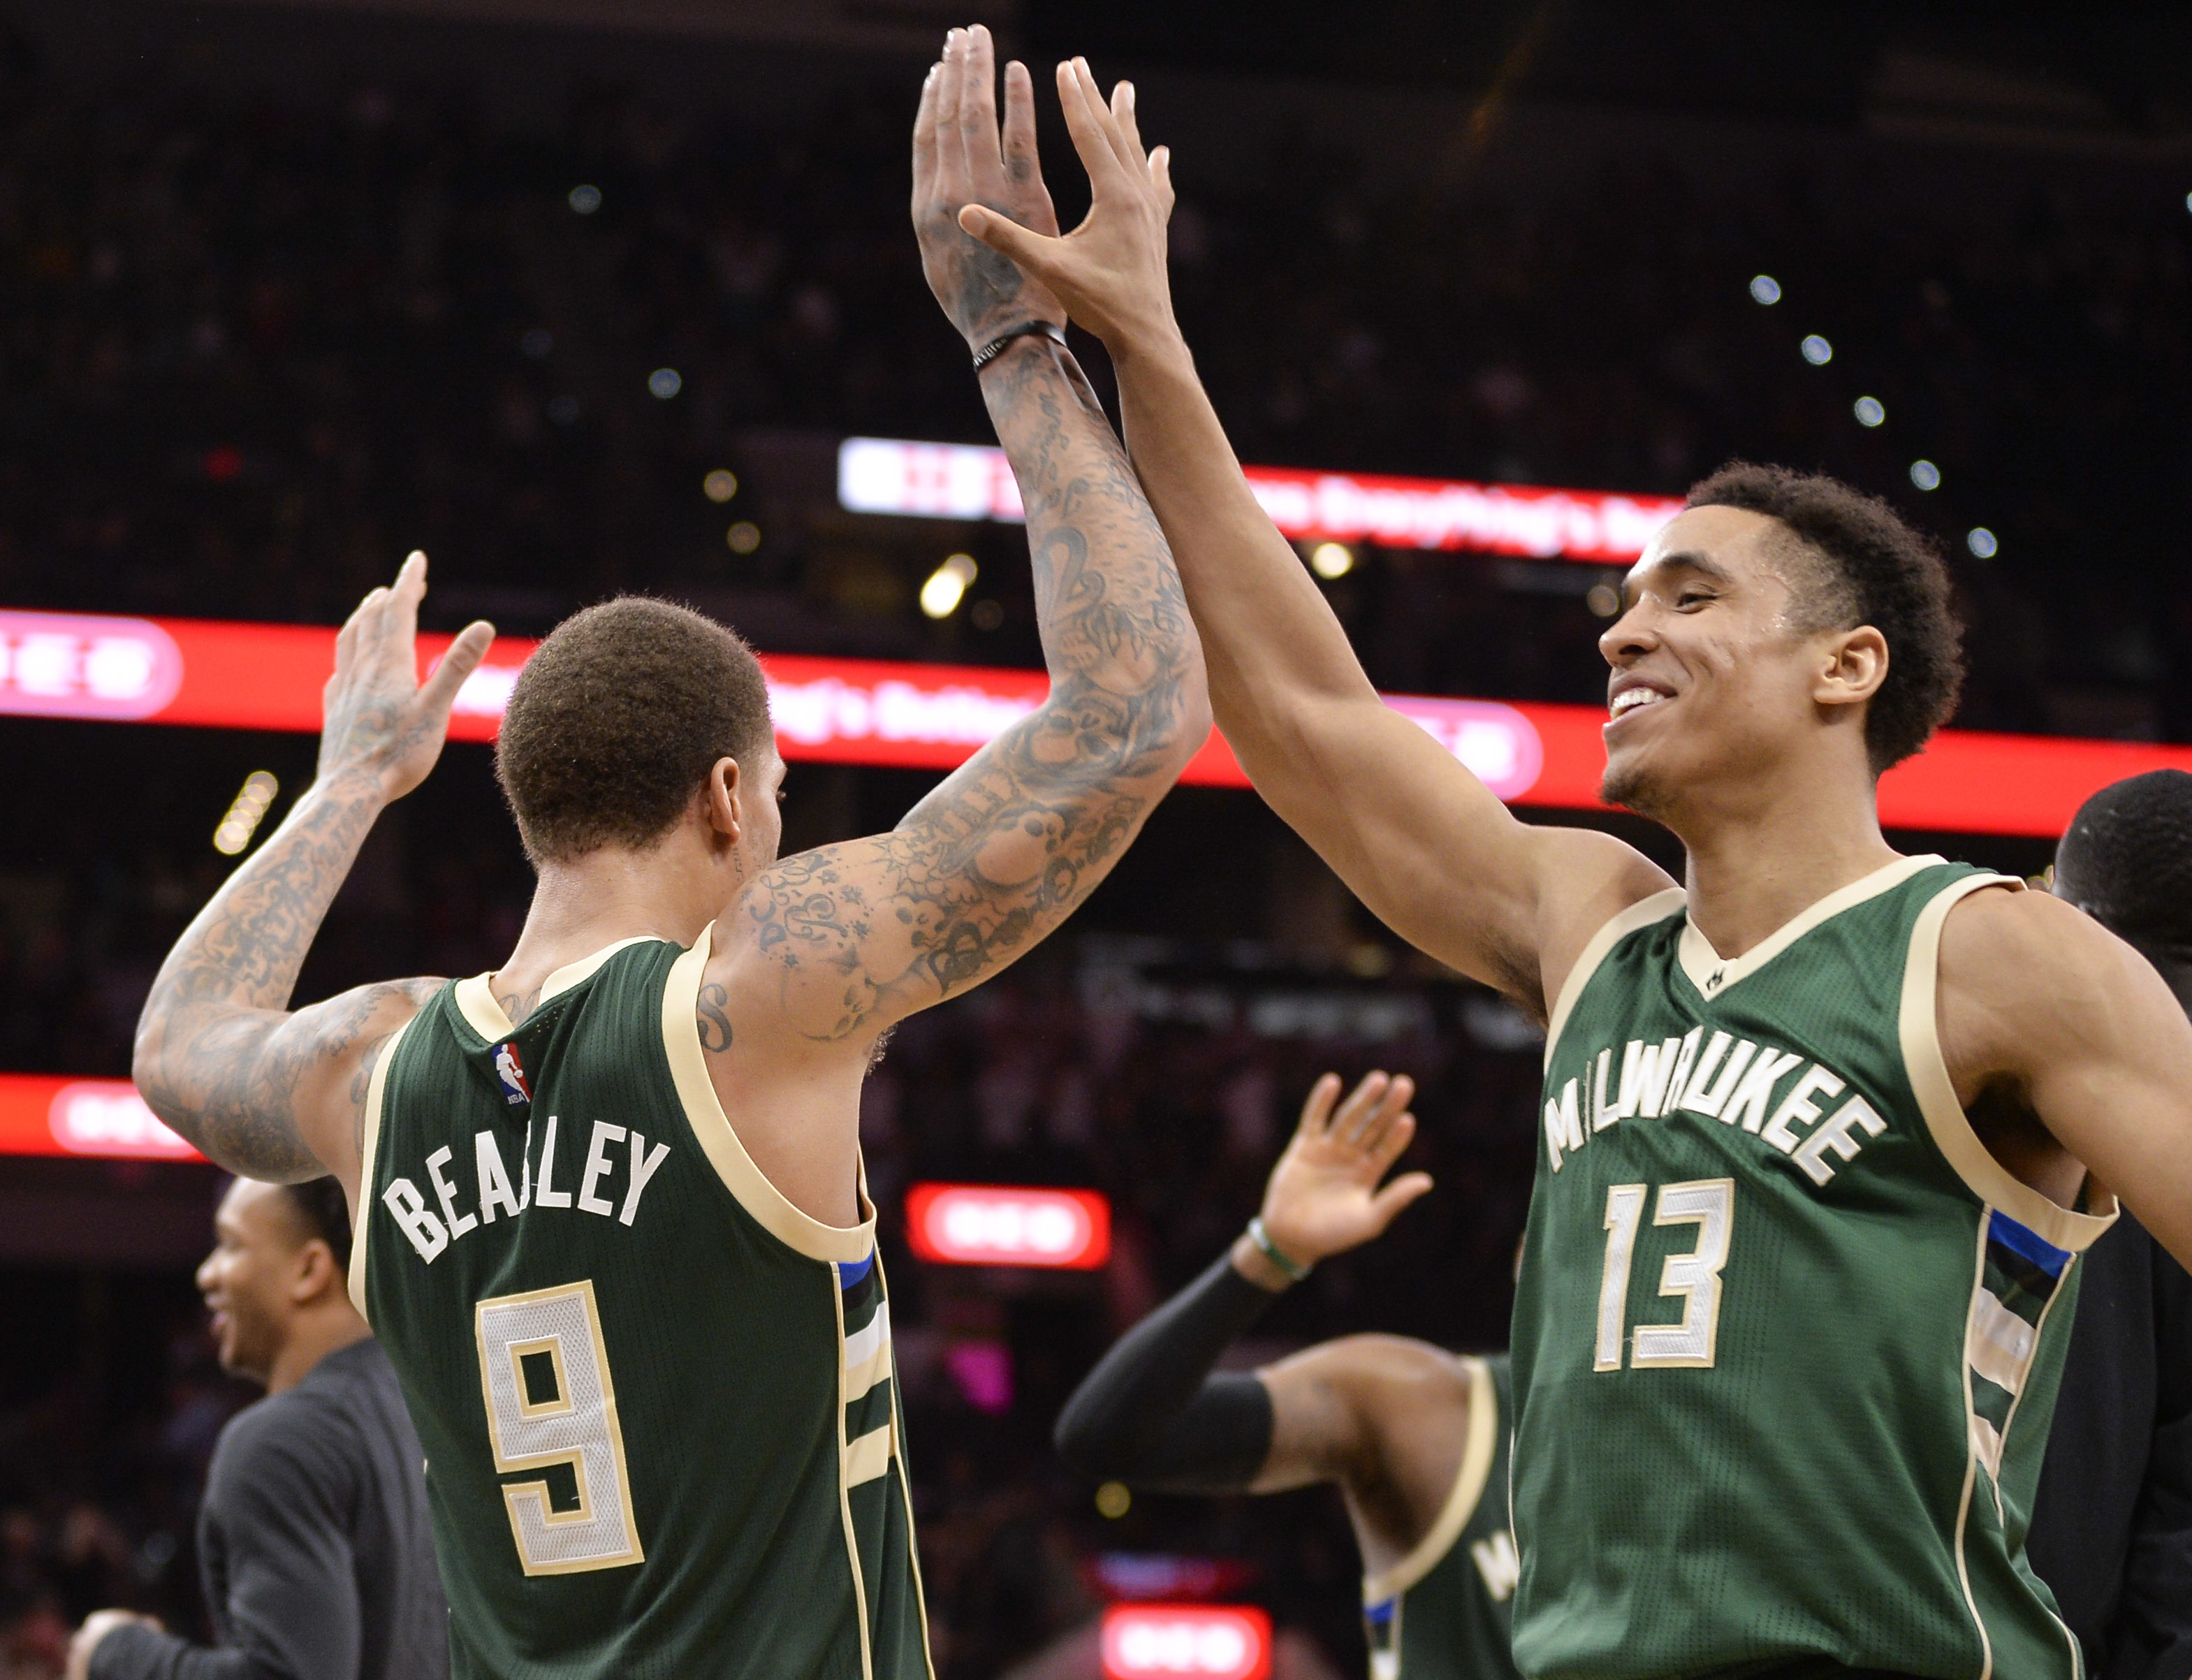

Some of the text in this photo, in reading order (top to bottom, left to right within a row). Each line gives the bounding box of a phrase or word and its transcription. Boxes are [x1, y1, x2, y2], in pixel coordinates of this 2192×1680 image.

[507, 1093, 525, 1105] NBA
[1593, 1178, 1735, 1373] 13
[476, 1279, 645, 1577] 9
